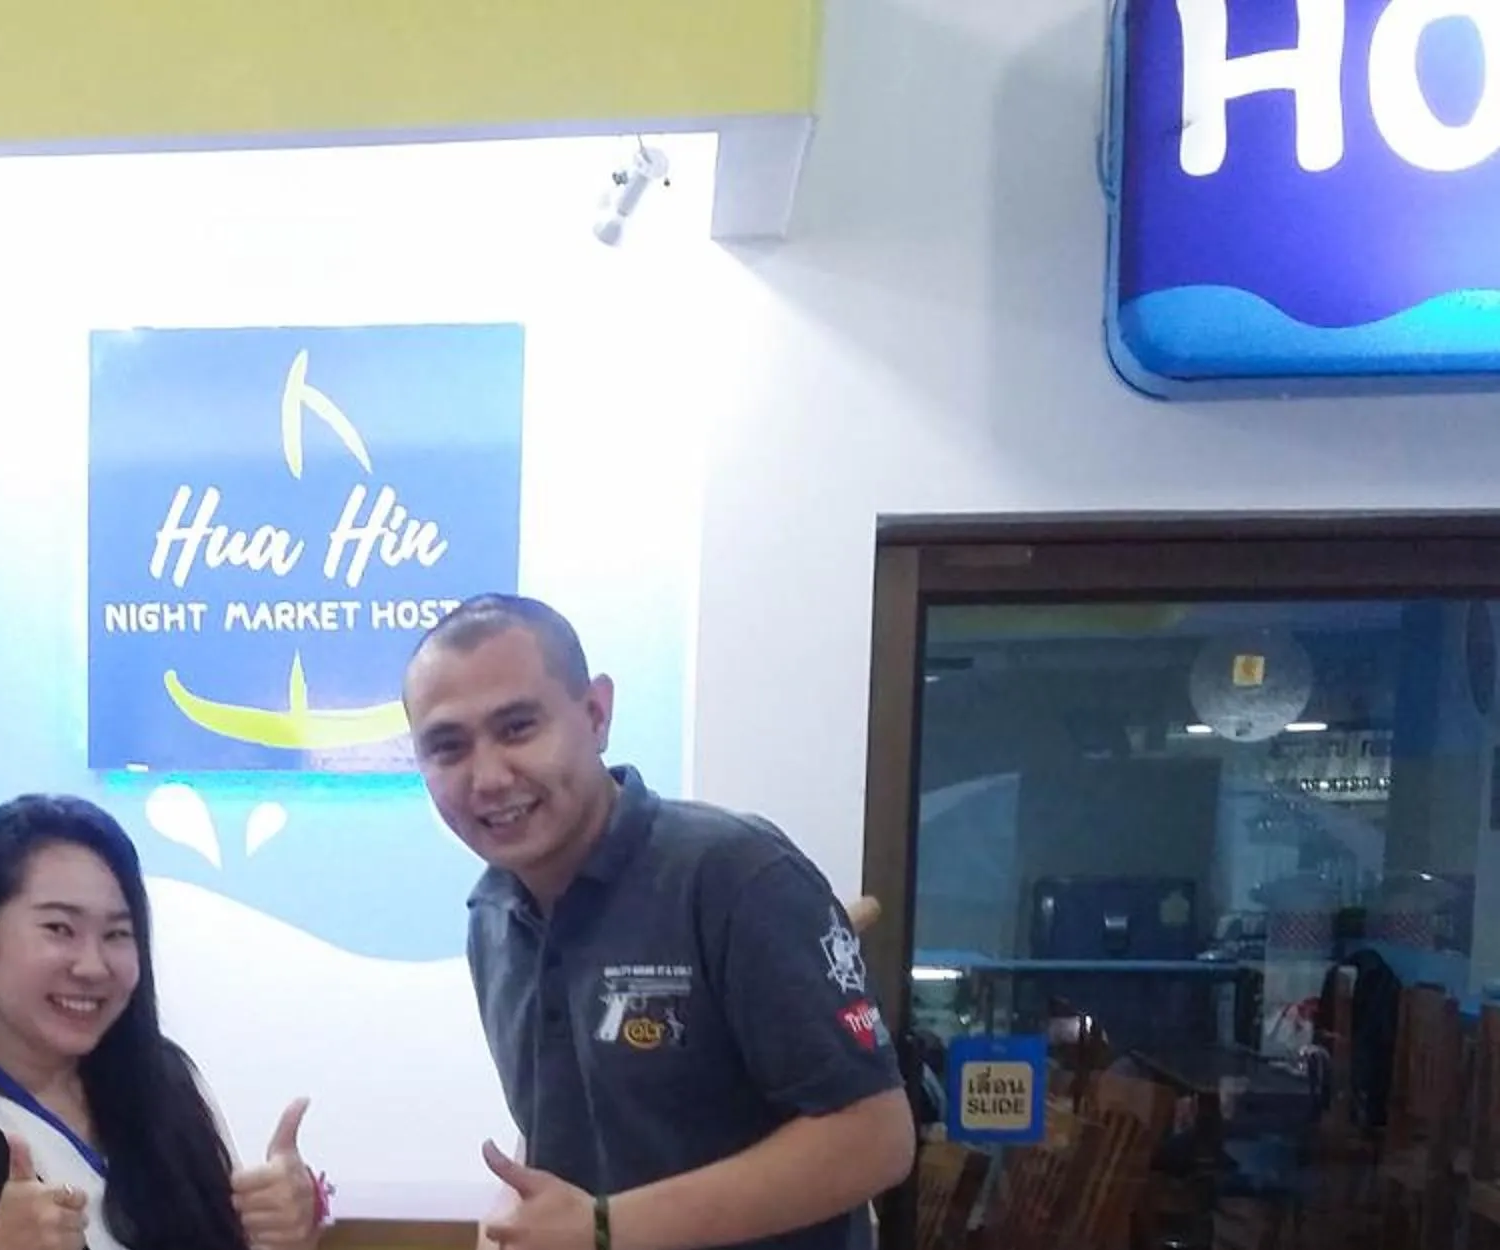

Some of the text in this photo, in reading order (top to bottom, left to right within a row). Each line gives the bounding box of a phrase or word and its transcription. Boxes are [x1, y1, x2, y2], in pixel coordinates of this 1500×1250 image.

[1177, 0, 1500, 176] HO
[148, 483, 448, 588] Hua Hin
[105, 602, 208, 632] NIGHT
[224, 601, 361, 631] MARKET
[967, 1097, 1025, 1115] SLIDE
